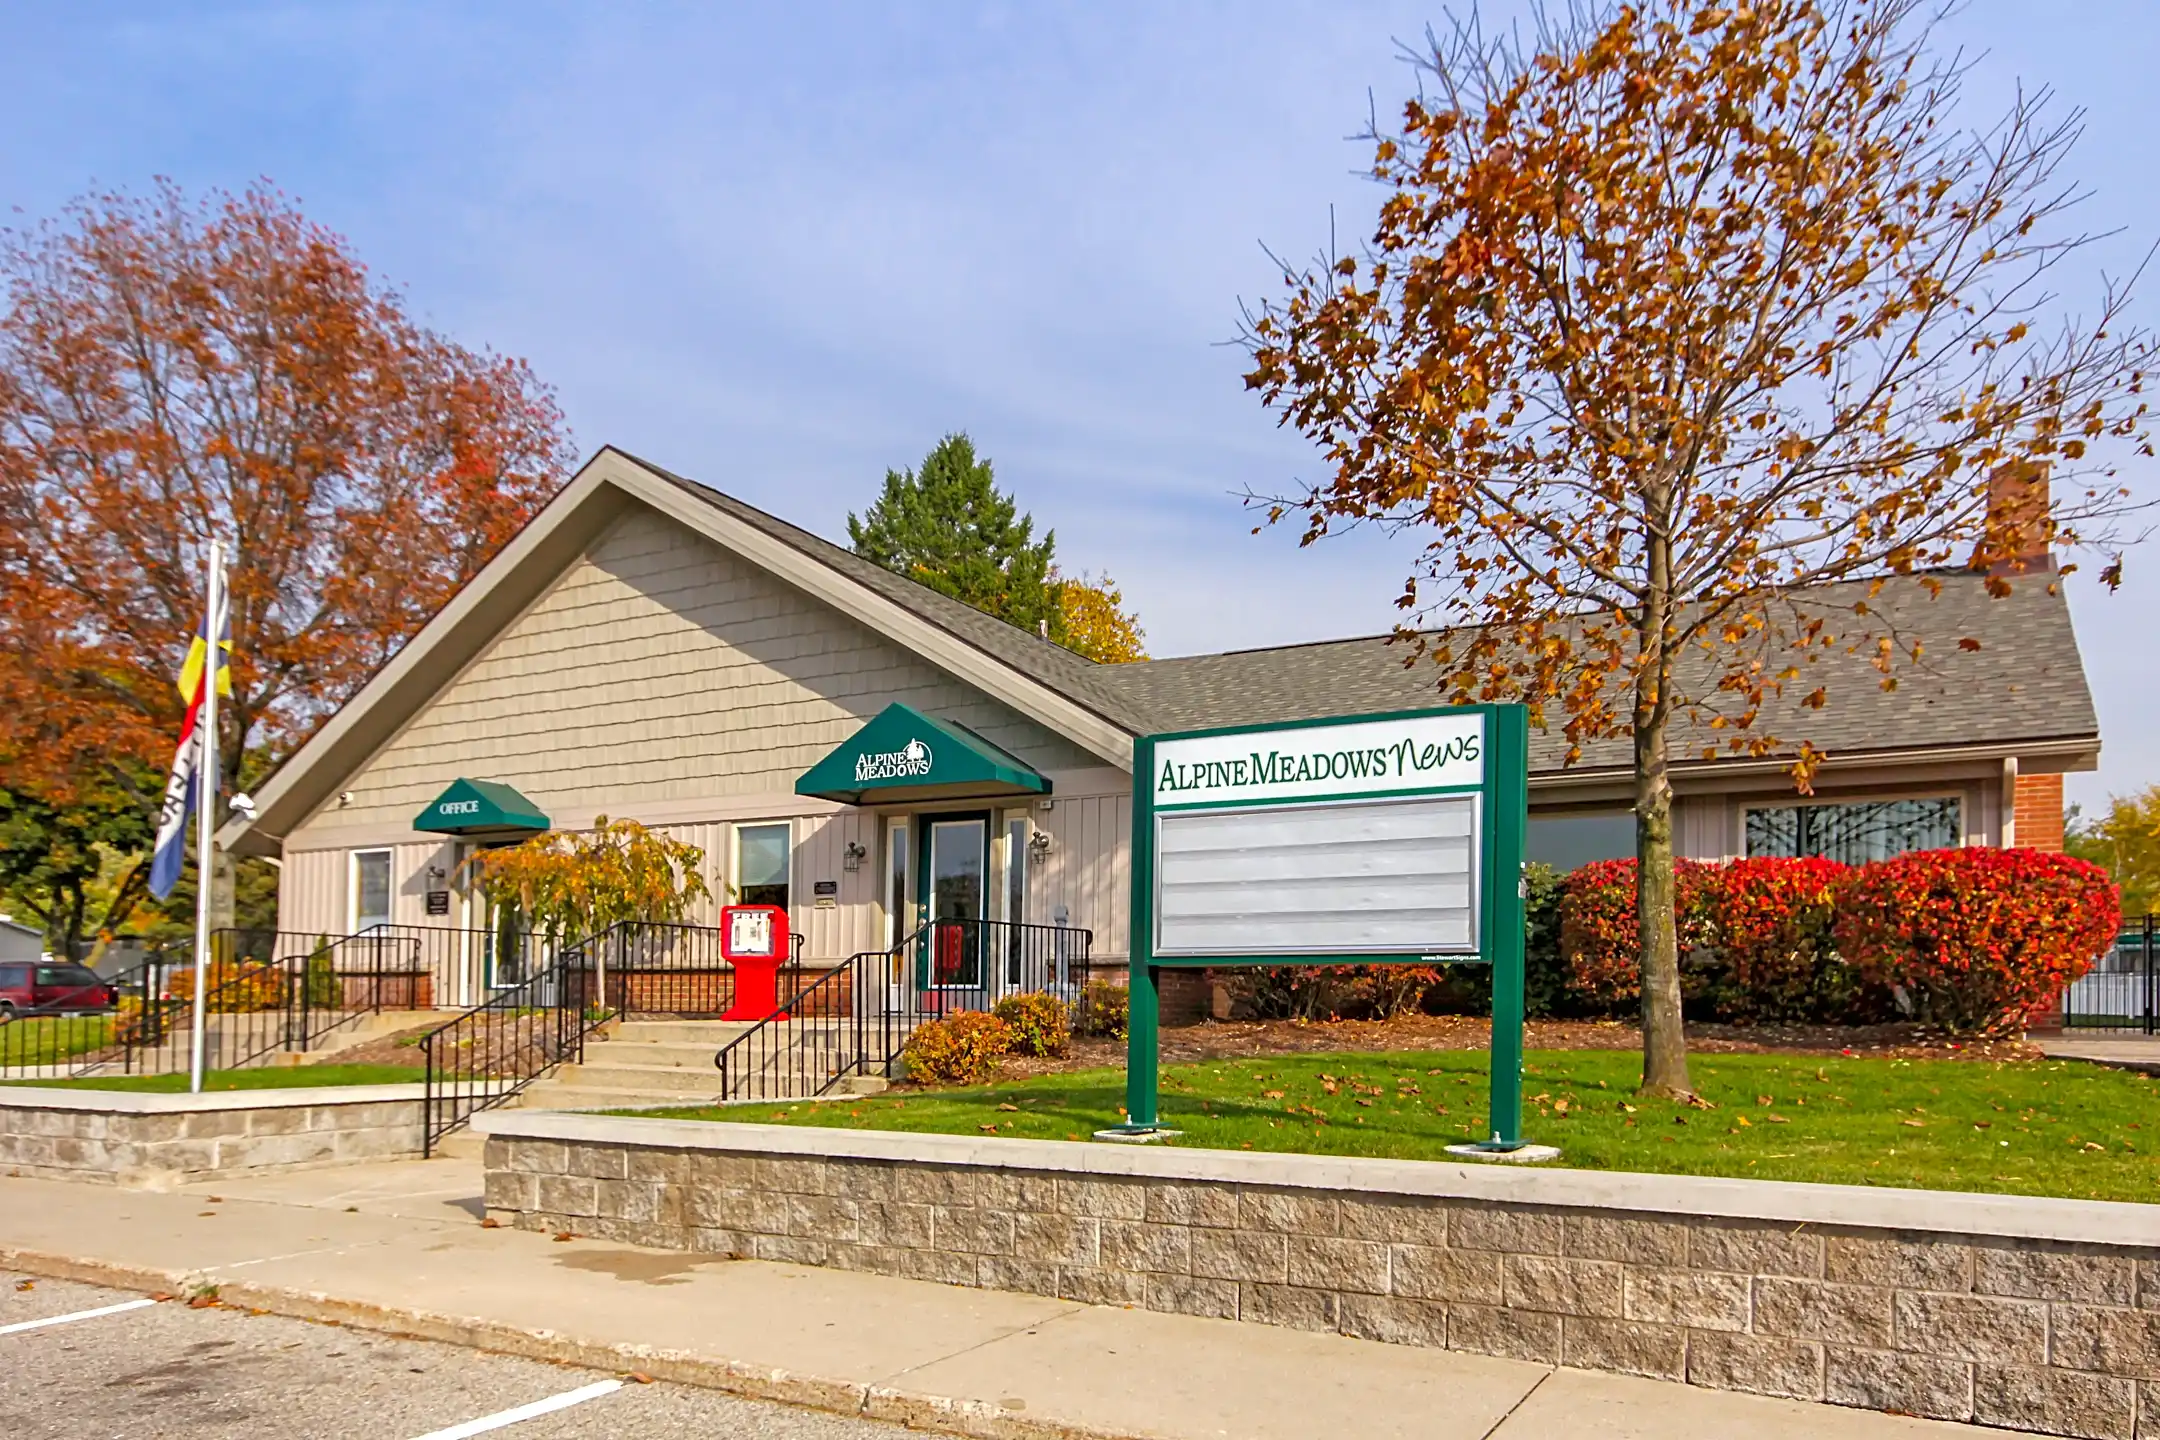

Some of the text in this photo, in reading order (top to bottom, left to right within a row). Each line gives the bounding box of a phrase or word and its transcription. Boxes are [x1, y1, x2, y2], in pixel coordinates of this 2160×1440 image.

[856, 752, 907, 768] ALPINE
[1157, 734, 1480, 792] ALPINE MEADOWS News
[855, 762, 929, 781] MEADOWS
[439, 800, 480, 815] OFFICE
